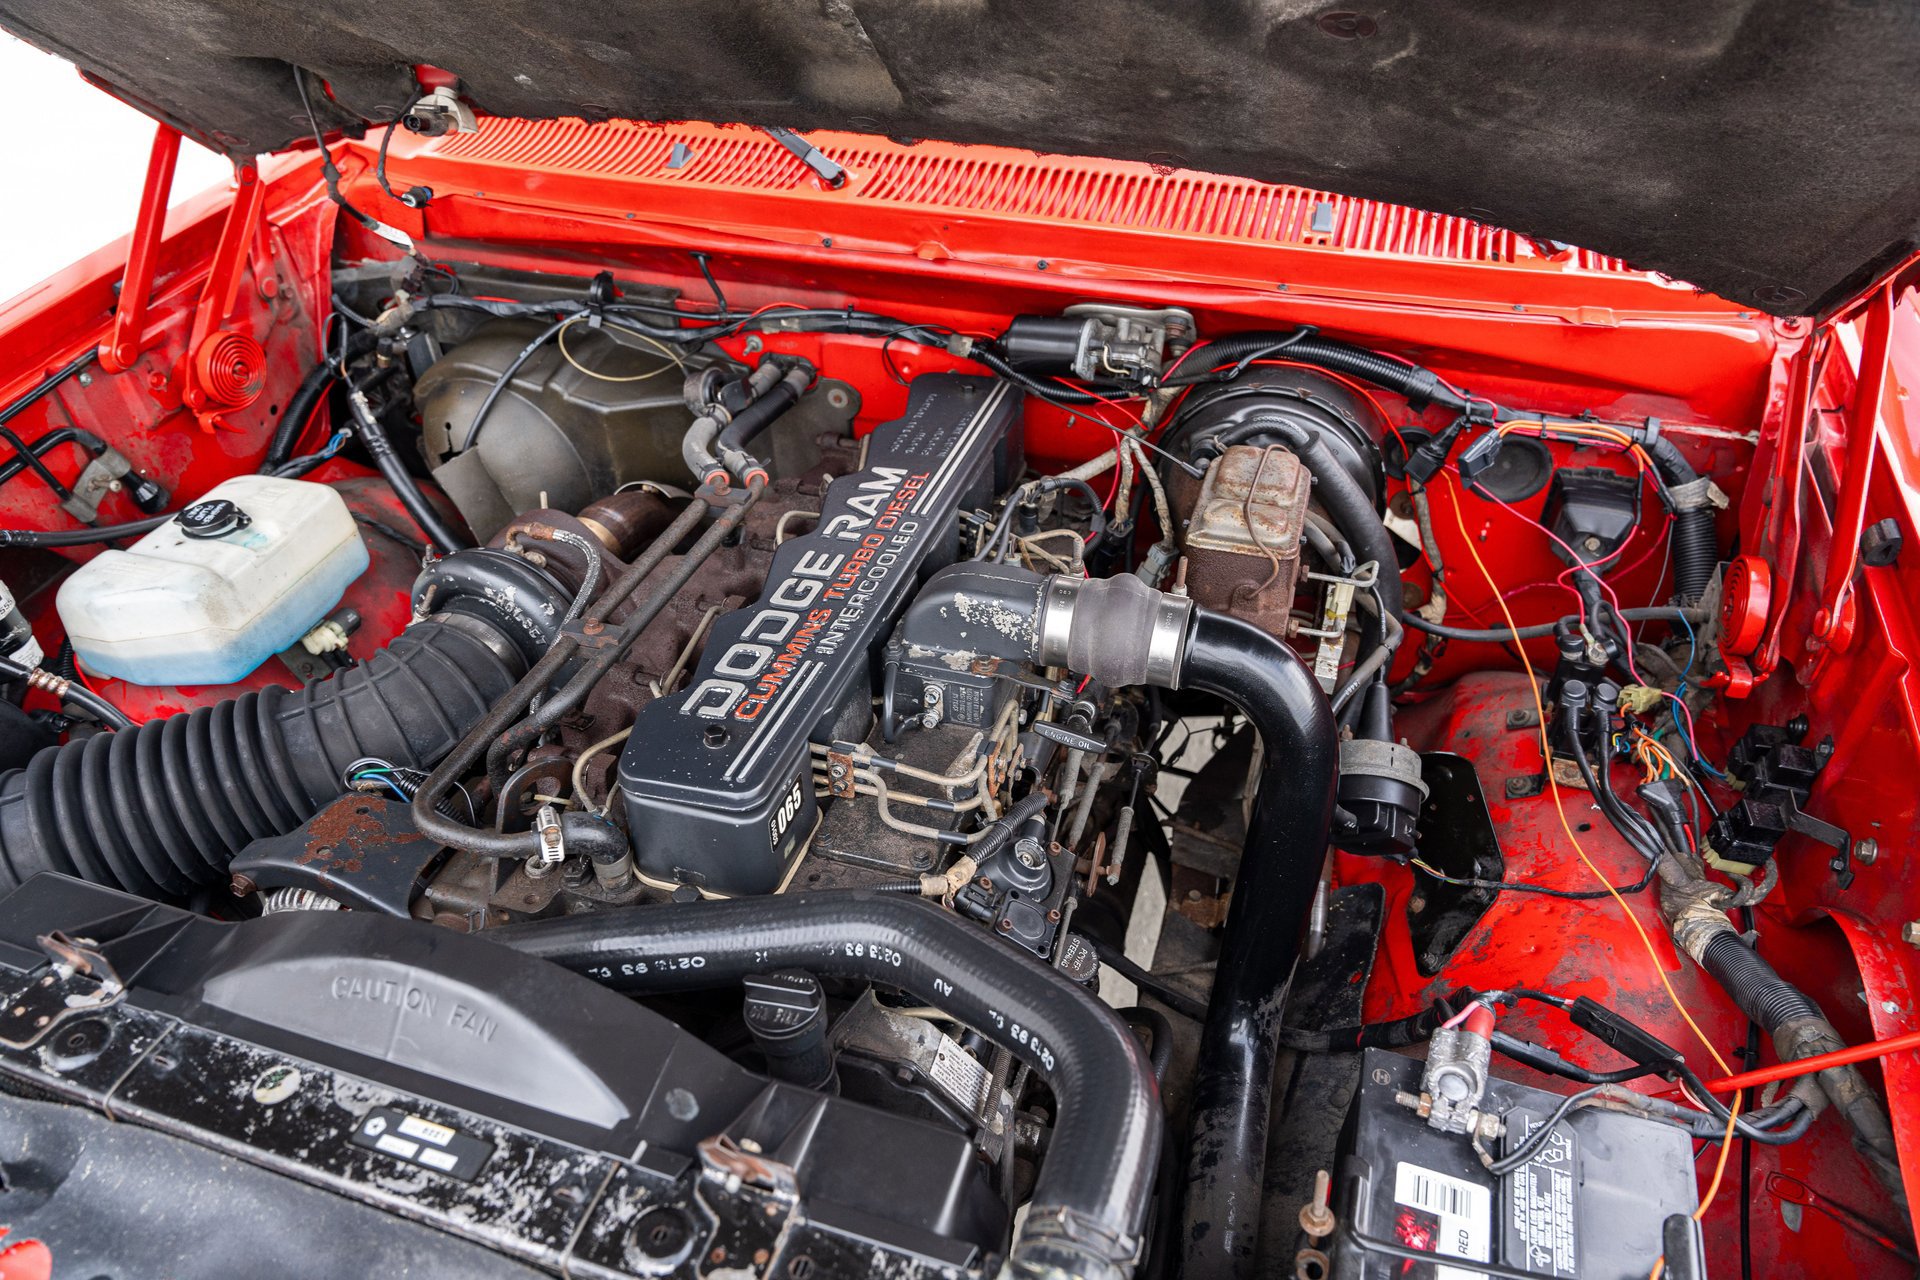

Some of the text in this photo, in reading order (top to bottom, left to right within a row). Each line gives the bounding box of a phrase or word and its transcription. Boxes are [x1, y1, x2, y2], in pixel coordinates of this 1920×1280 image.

[680, 466, 909, 720] DODGE RAM
[733, 608, 832, 722] CUMMINS
[823, 533, 886, 600] TURBO
[875, 471, 930, 531] DIESEL
[815, 521, 919, 655] INTERCOOLED
[1044, 729, 1092, 751] ENGINE OIL
[777, 782, 802, 834] 065
[1060, 937, 1081, 968] STEERING
[1072, 947, 1088, 971] POWER
[331, 976, 499, 1044] CAUTION FAN
[1010, 1023, 1029, 1045] 93
[1029, 1036, 1055, 1072] 0213
[1458, 1229, 1469, 1255] RED
